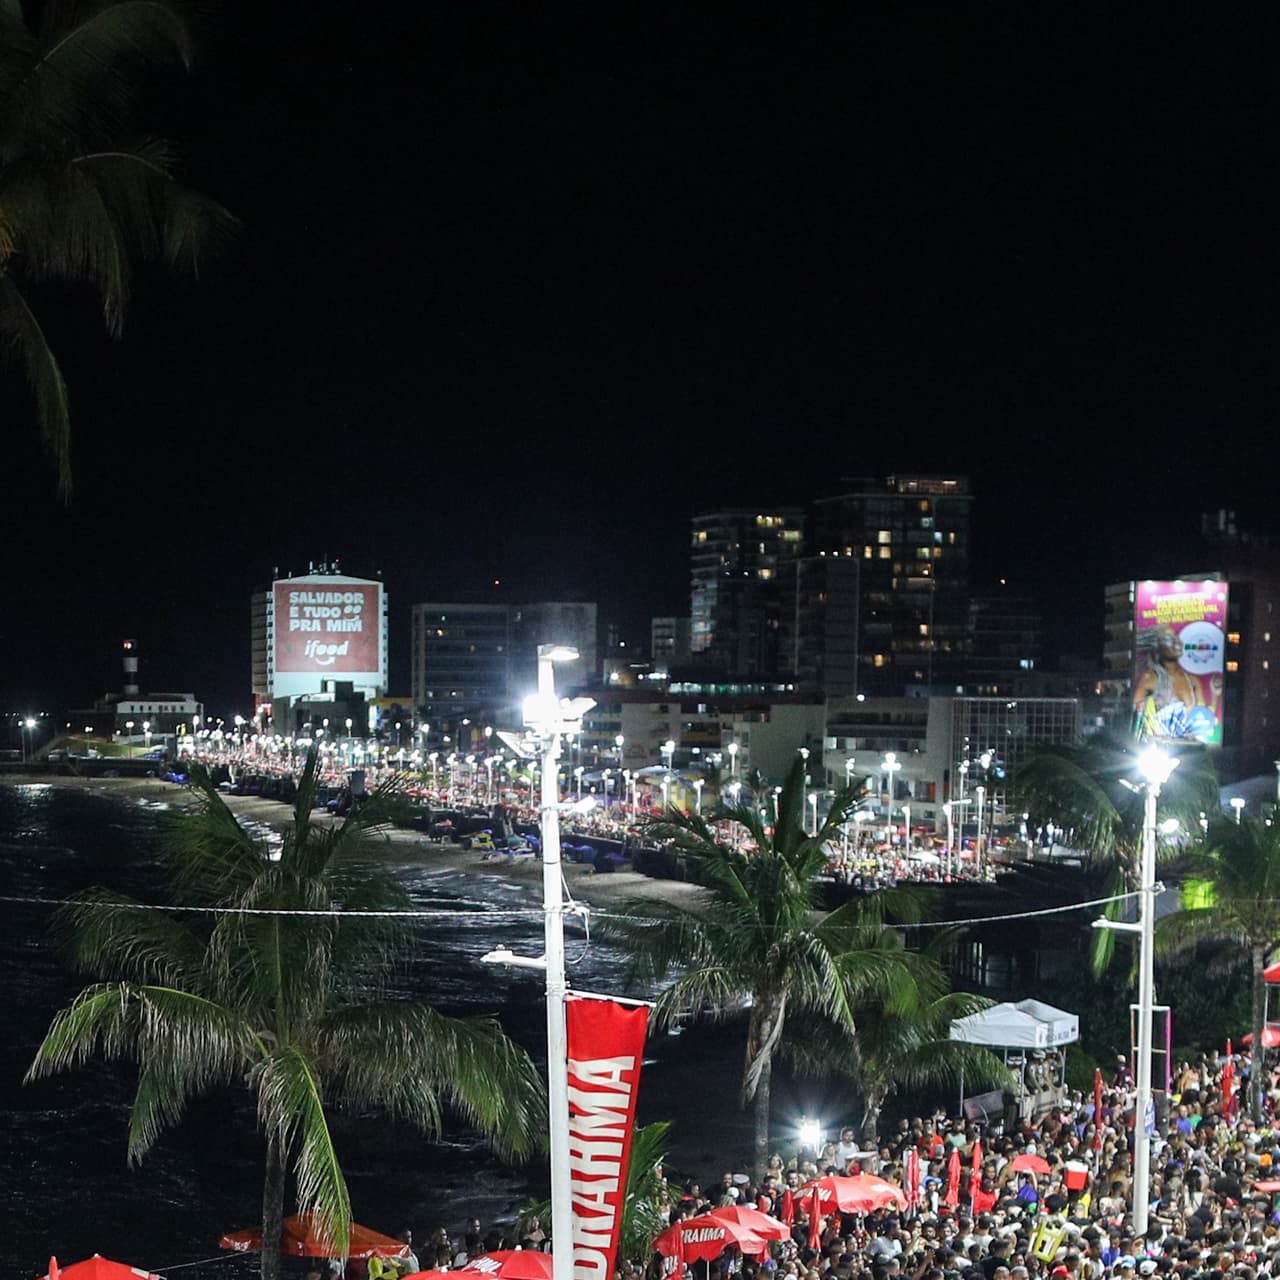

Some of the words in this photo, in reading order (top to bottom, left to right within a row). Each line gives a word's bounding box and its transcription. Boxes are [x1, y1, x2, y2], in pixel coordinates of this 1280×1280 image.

[289, 592, 364, 605] SALVADOR
[290, 604, 299, 617] É
[304, 606, 340, 618] TUDO
[289, 619, 325, 632] PRA
[326, 619, 362, 632] MIM
[304, 640, 349, 658] ifood
